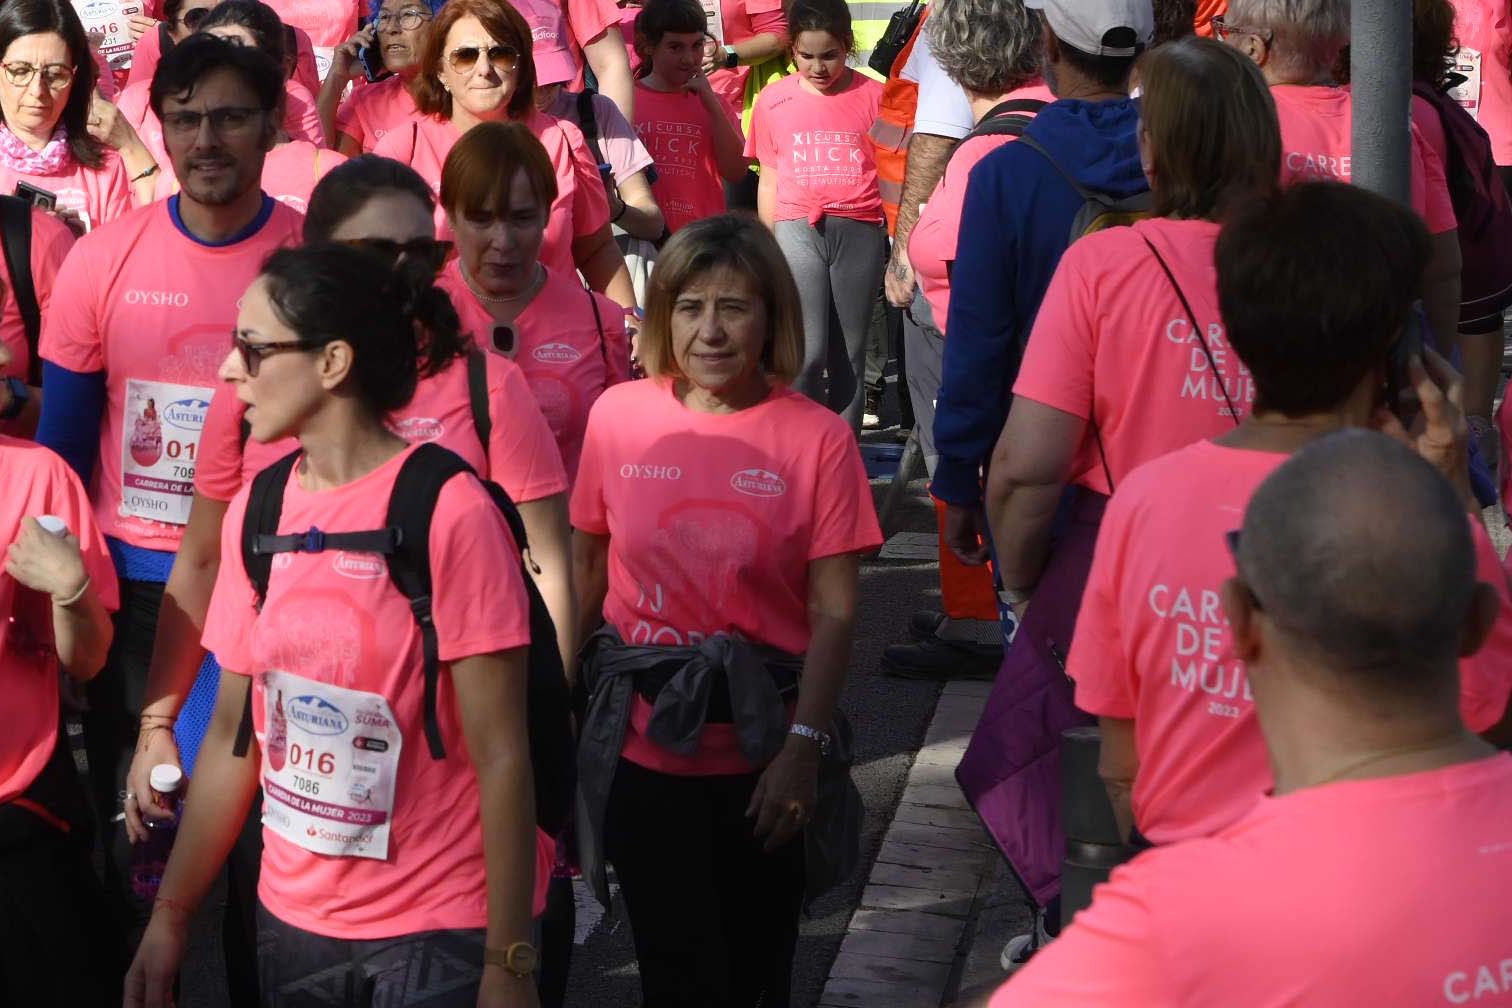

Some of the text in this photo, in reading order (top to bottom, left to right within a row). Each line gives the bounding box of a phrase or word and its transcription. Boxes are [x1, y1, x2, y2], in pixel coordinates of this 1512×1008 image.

[104, 36, 117, 45] 231
[793, 132, 810, 146] XI
[793, 147, 861, 163] NICK
[1286, 152, 1352, 177] CARRE
[124, 289, 189, 308] OYSHO
[1166, 318, 1233, 349] CAR
[1190, 347, 1226, 376] DE
[1180, 375, 1255, 403] MUJE
[167, 441, 196, 460] 01
[172, 464, 195, 479] 709
[619, 463, 682, 480] OYSHO
[170, 483, 183, 491] DE
[131, 495, 169, 512] OYSHO
[1148, 584, 1225, 625] CAR
[1176, 626, 1222, 661] DE
[1208, 702, 1239, 717] 2023
[290, 743, 336, 775] 016
[293, 775, 320, 796] 7086
[312, 804, 345, 819] MUJER
[1444, 958, 1512, 1003] CAR
